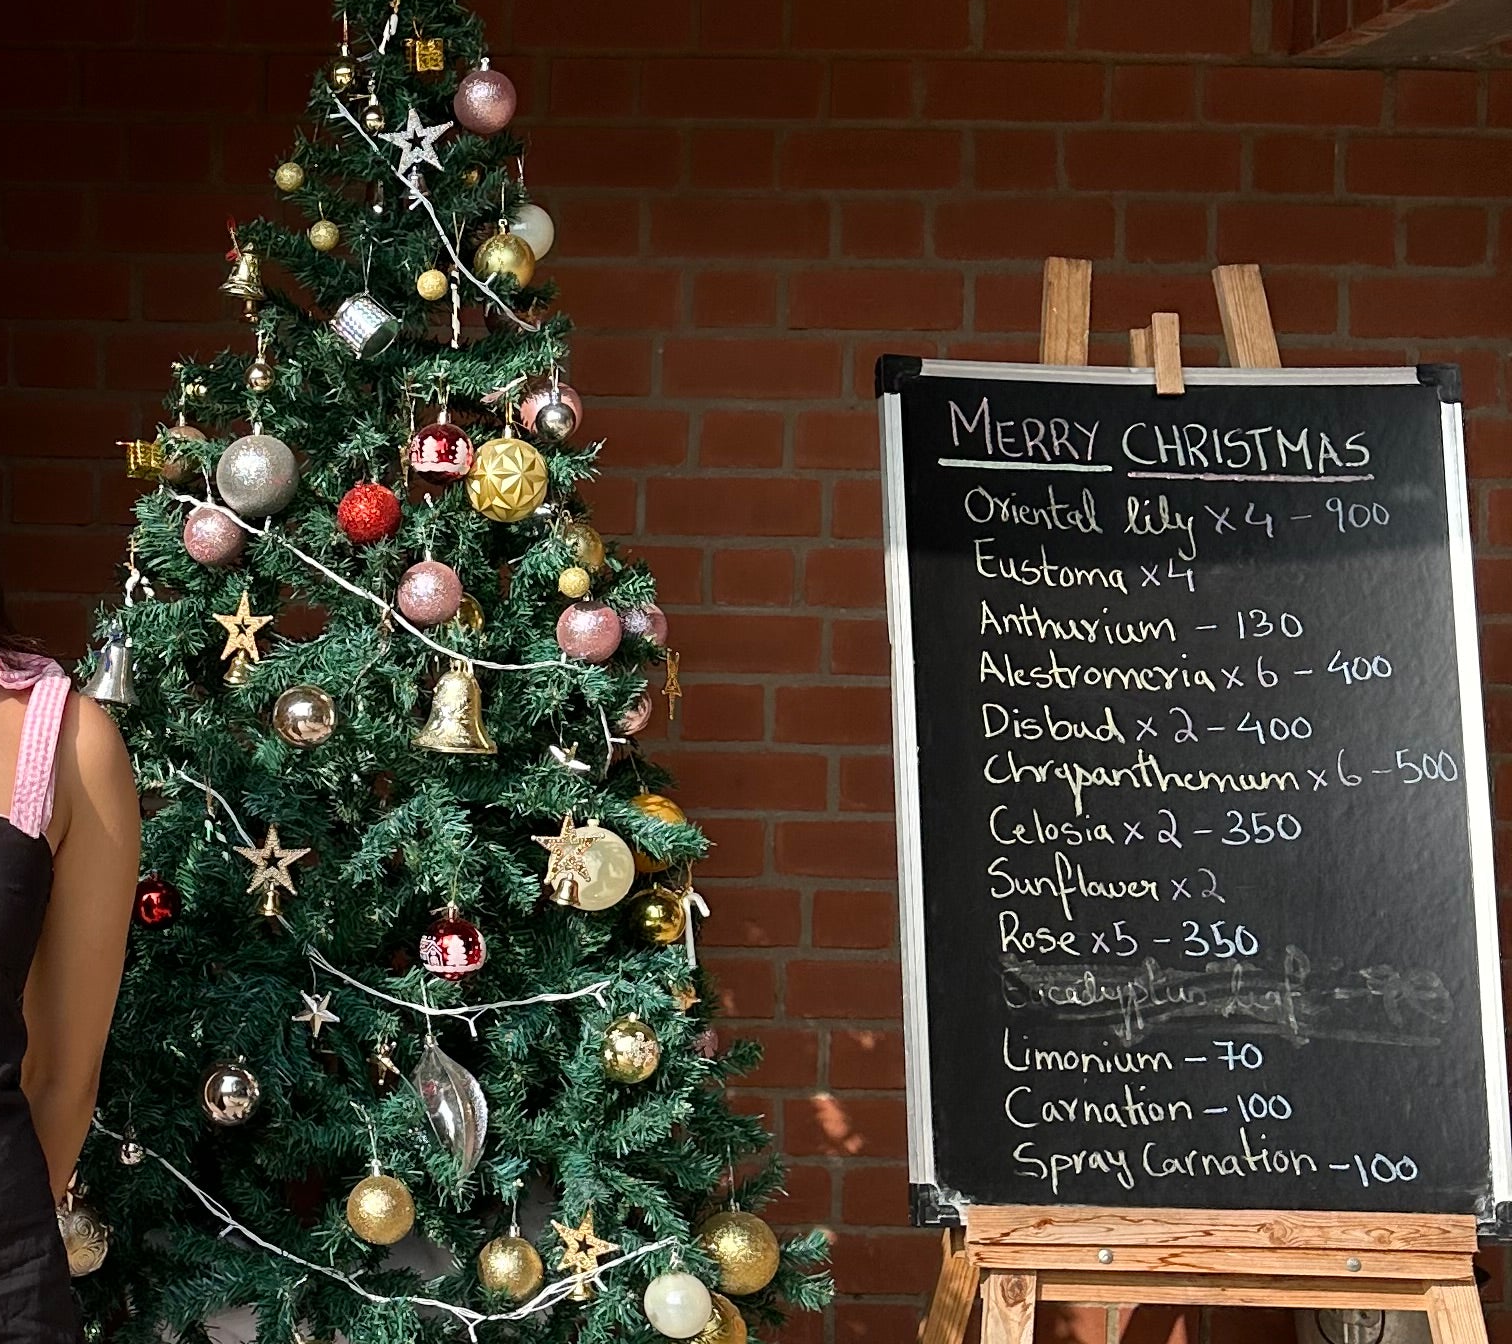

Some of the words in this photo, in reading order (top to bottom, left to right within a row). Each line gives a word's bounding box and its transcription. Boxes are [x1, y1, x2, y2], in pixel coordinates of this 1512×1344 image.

[949, 397, 1100, 461] MERRY
[1122, 423, 1370, 473] CHRISTMAS
[965, 485, 1103, 533] Oriental
[1326, 498, 1390, 532] 900
[974, 538, 1127, 594] Eustoma
[980, 600, 1176, 644] Anthurium
[1238, 609, 1303, 639] 130
[1328, 650, 1392, 684] 400
[982, 703, 1125, 744] Disbud
[990, 805, 1115, 845] Celosia
[988, 852, 1159, 920] Sunflower
[999, 911, 1080, 955] Rose
[1183, 921, 1258, 957] 350
[1004, 1028, 1172, 1073] Limonium
[1005, 1084, 1192, 1128] Carnation
[1013, 1142, 1134, 1195] Spray
[1143, 1127, 1318, 1176] Carnation
